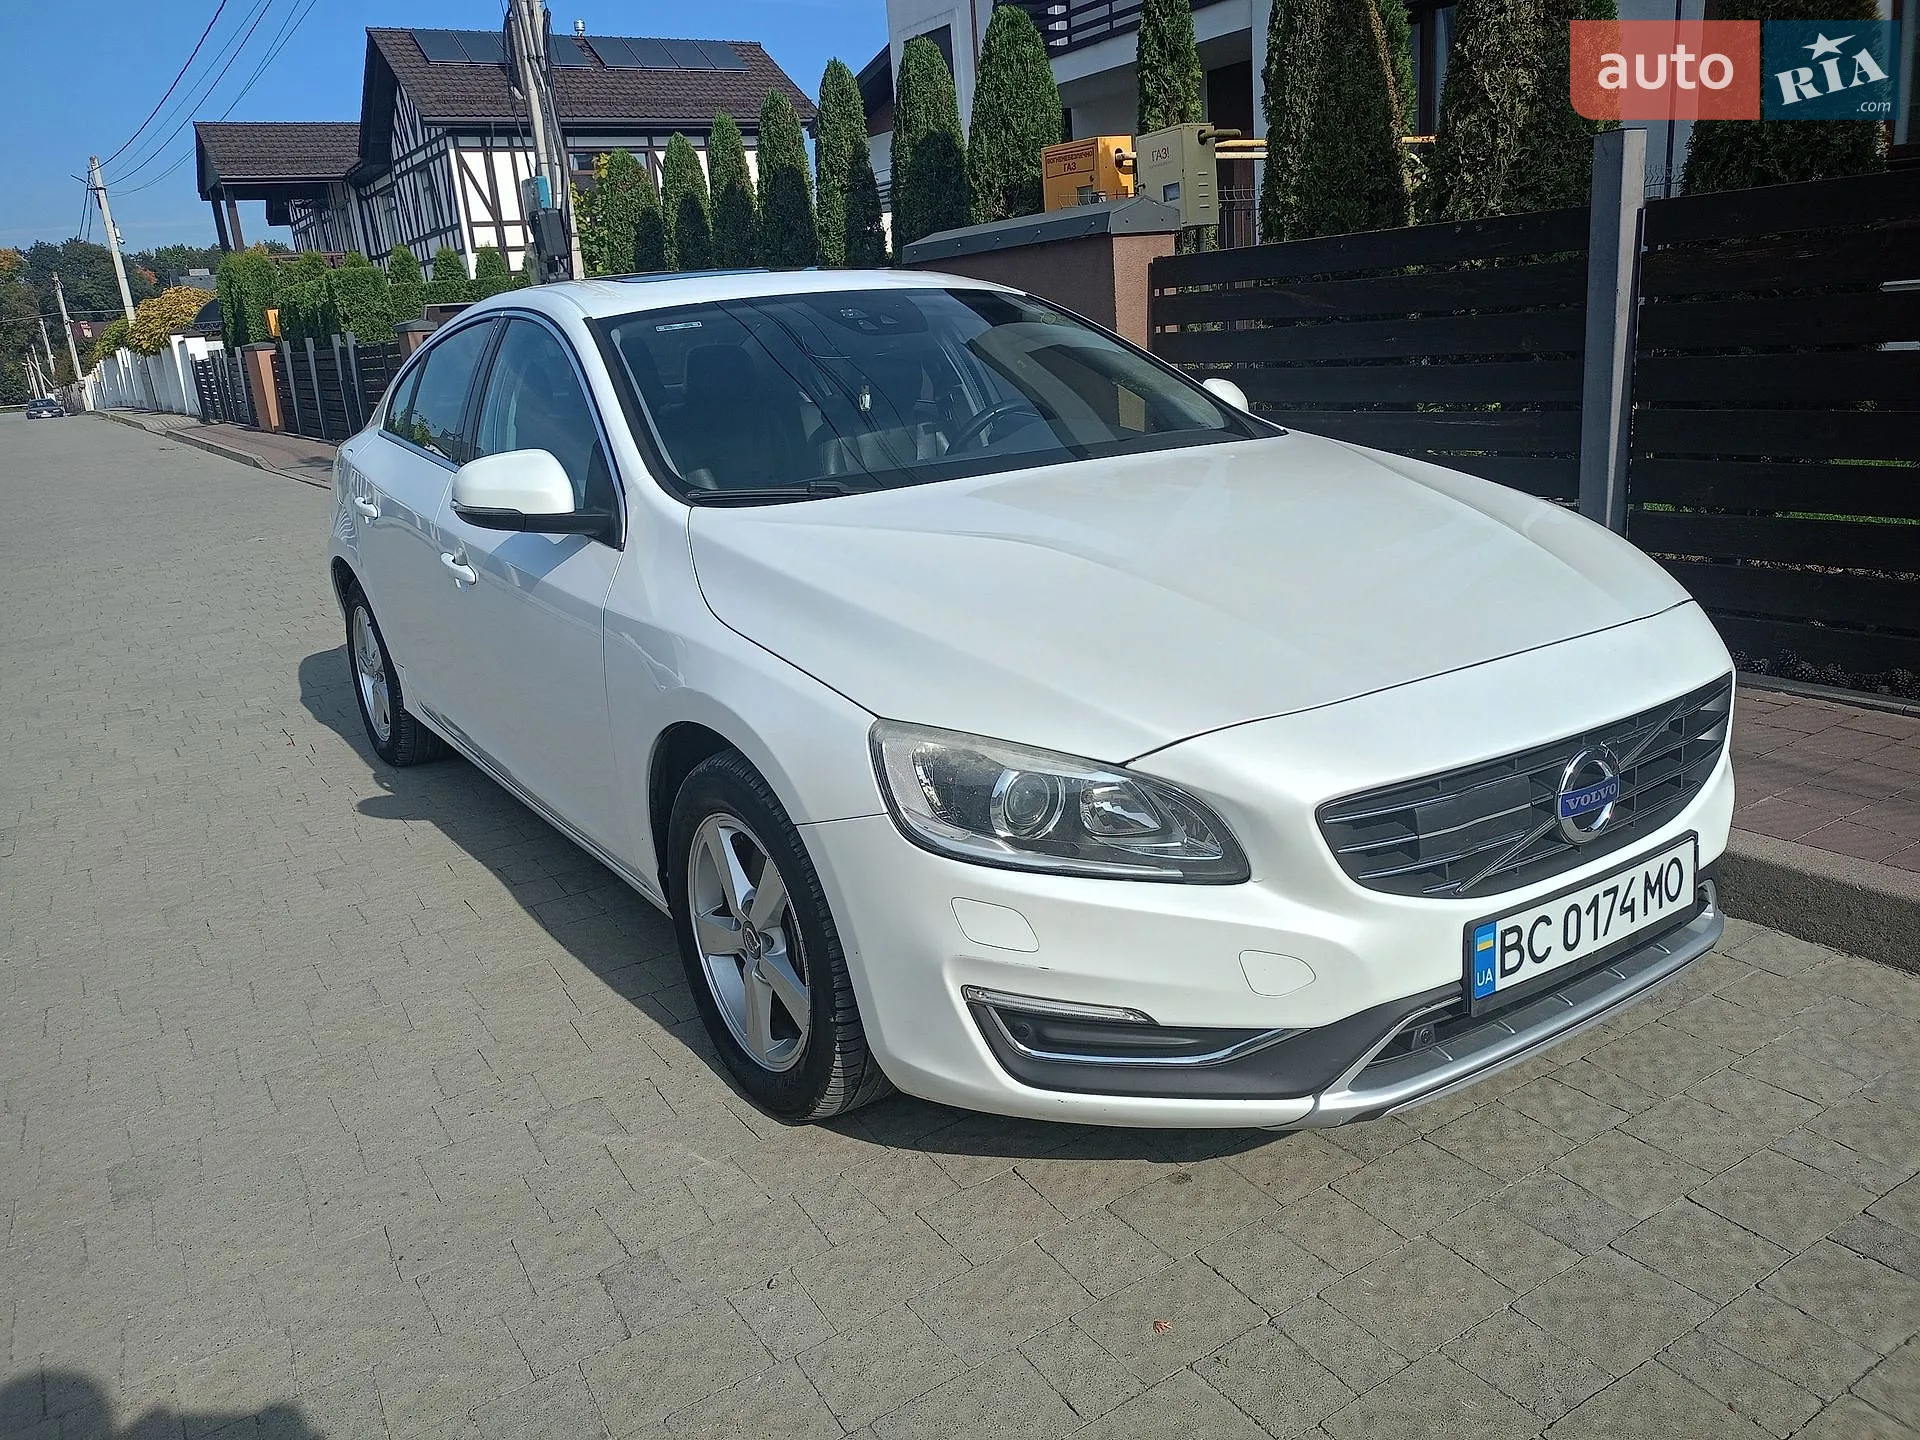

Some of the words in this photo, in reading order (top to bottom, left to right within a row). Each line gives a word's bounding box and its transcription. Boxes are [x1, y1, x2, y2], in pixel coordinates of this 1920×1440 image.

[1151, 147, 1170, 162] ГАЗ!
[1063, 162, 1077, 172] ГАЗ
[1565, 782, 1617, 810] VOLVO
[1500, 915, 1552, 979] BC
[1562, 876, 1636, 952] 0174
[1643, 856, 1684, 917] MO
[1476, 970, 1494, 987] UA
